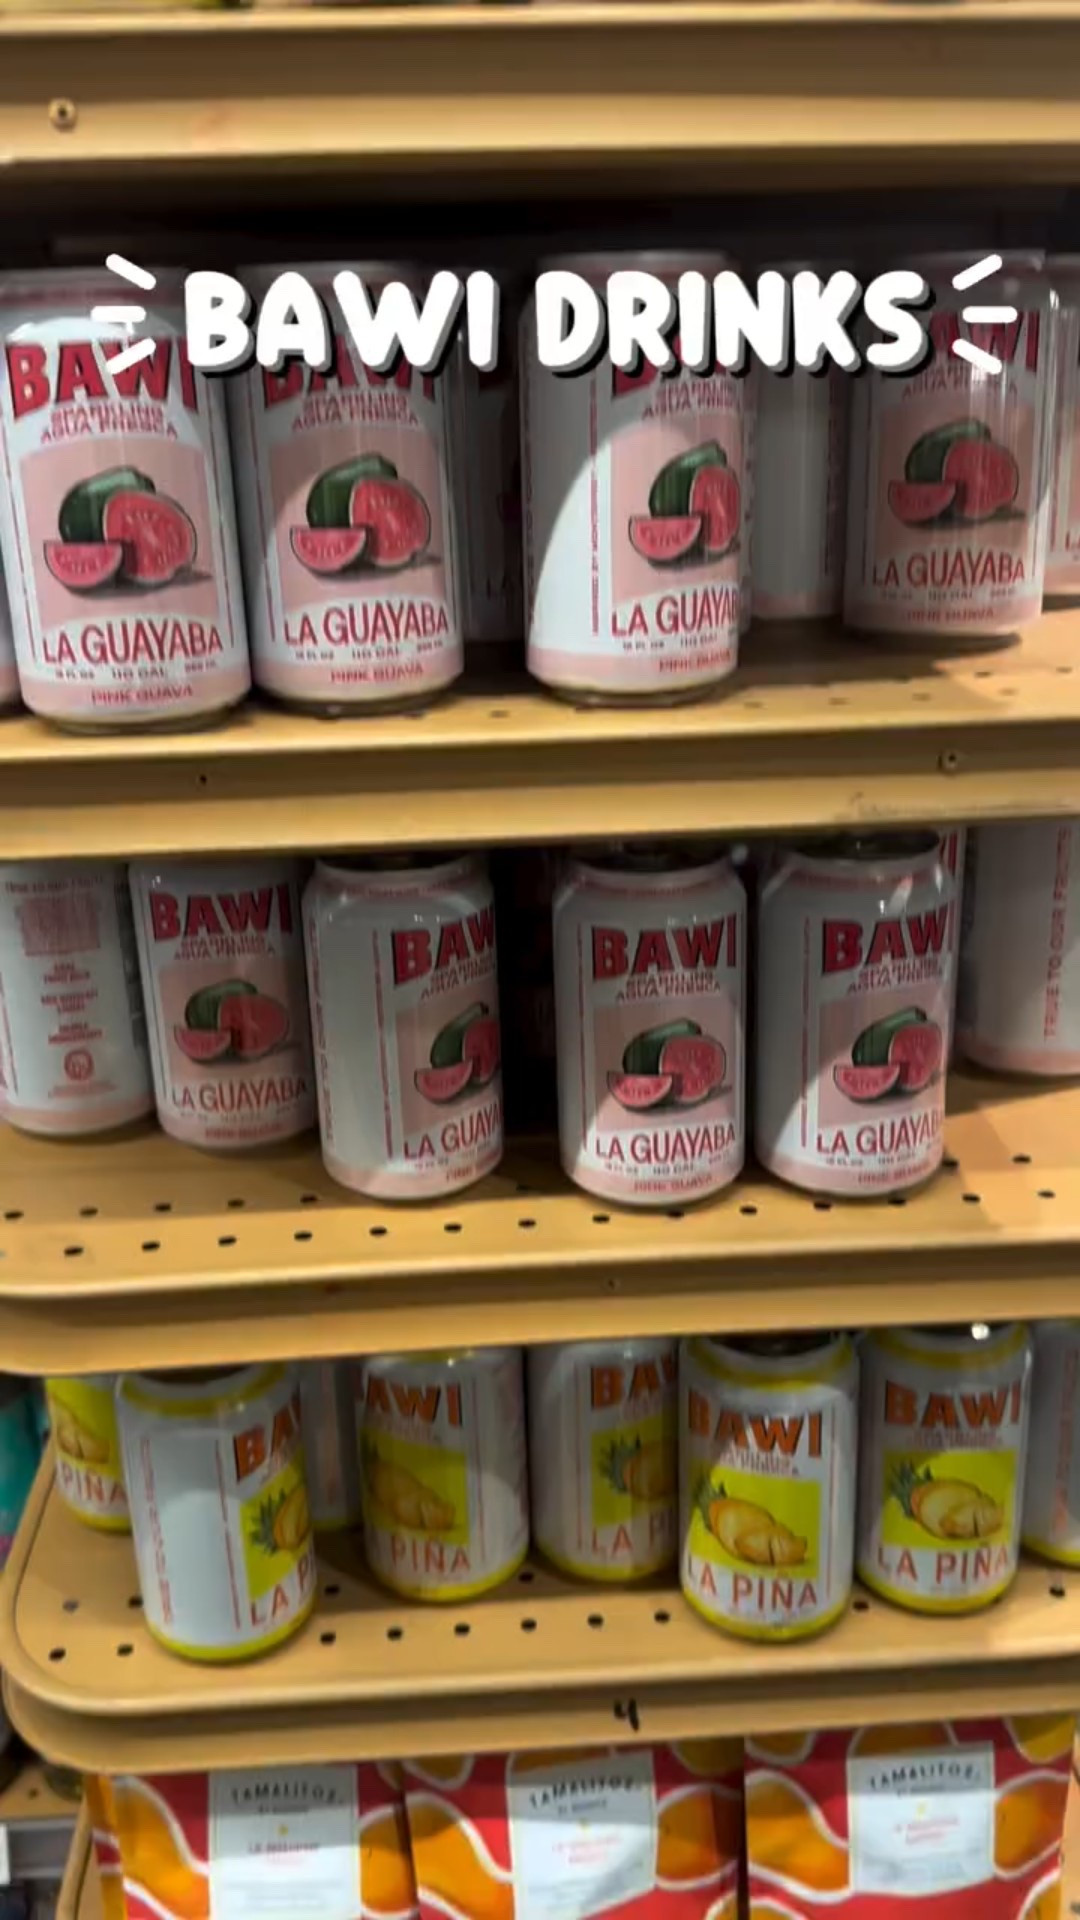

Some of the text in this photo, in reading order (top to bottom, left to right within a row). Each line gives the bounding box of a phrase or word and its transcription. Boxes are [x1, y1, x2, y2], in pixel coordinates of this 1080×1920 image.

[873, 547, 1025, 588] LA GUAYABA
[43, 618, 224, 665] LA GUAYABA
[284, 600, 449, 646] LA GUAYABA
[611, 602, 649, 638] LA
[149, 883, 293, 942] BAWI
[591, 912, 737, 981] BAWI
[172, 1077, 307, 1112] LA GUAYABA
[403, 1133, 435, 1161] LA
[596, 1122, 736, 1165] LA GUAYABA
[817, 1130, 850, 1156] LA
[687, 1387, 822, 1458] BAWI
[884, 1379, 1022, 1427] BAWI
[591, 1529, 633, 1556] LA
[878, 1544, 1009, 1584] LA PIÑA
[687, 1554, 818, 1610] LA PIÑA
[251, 1584, 289, 1627] LA
[613, 1698, 639, 1731] 4
